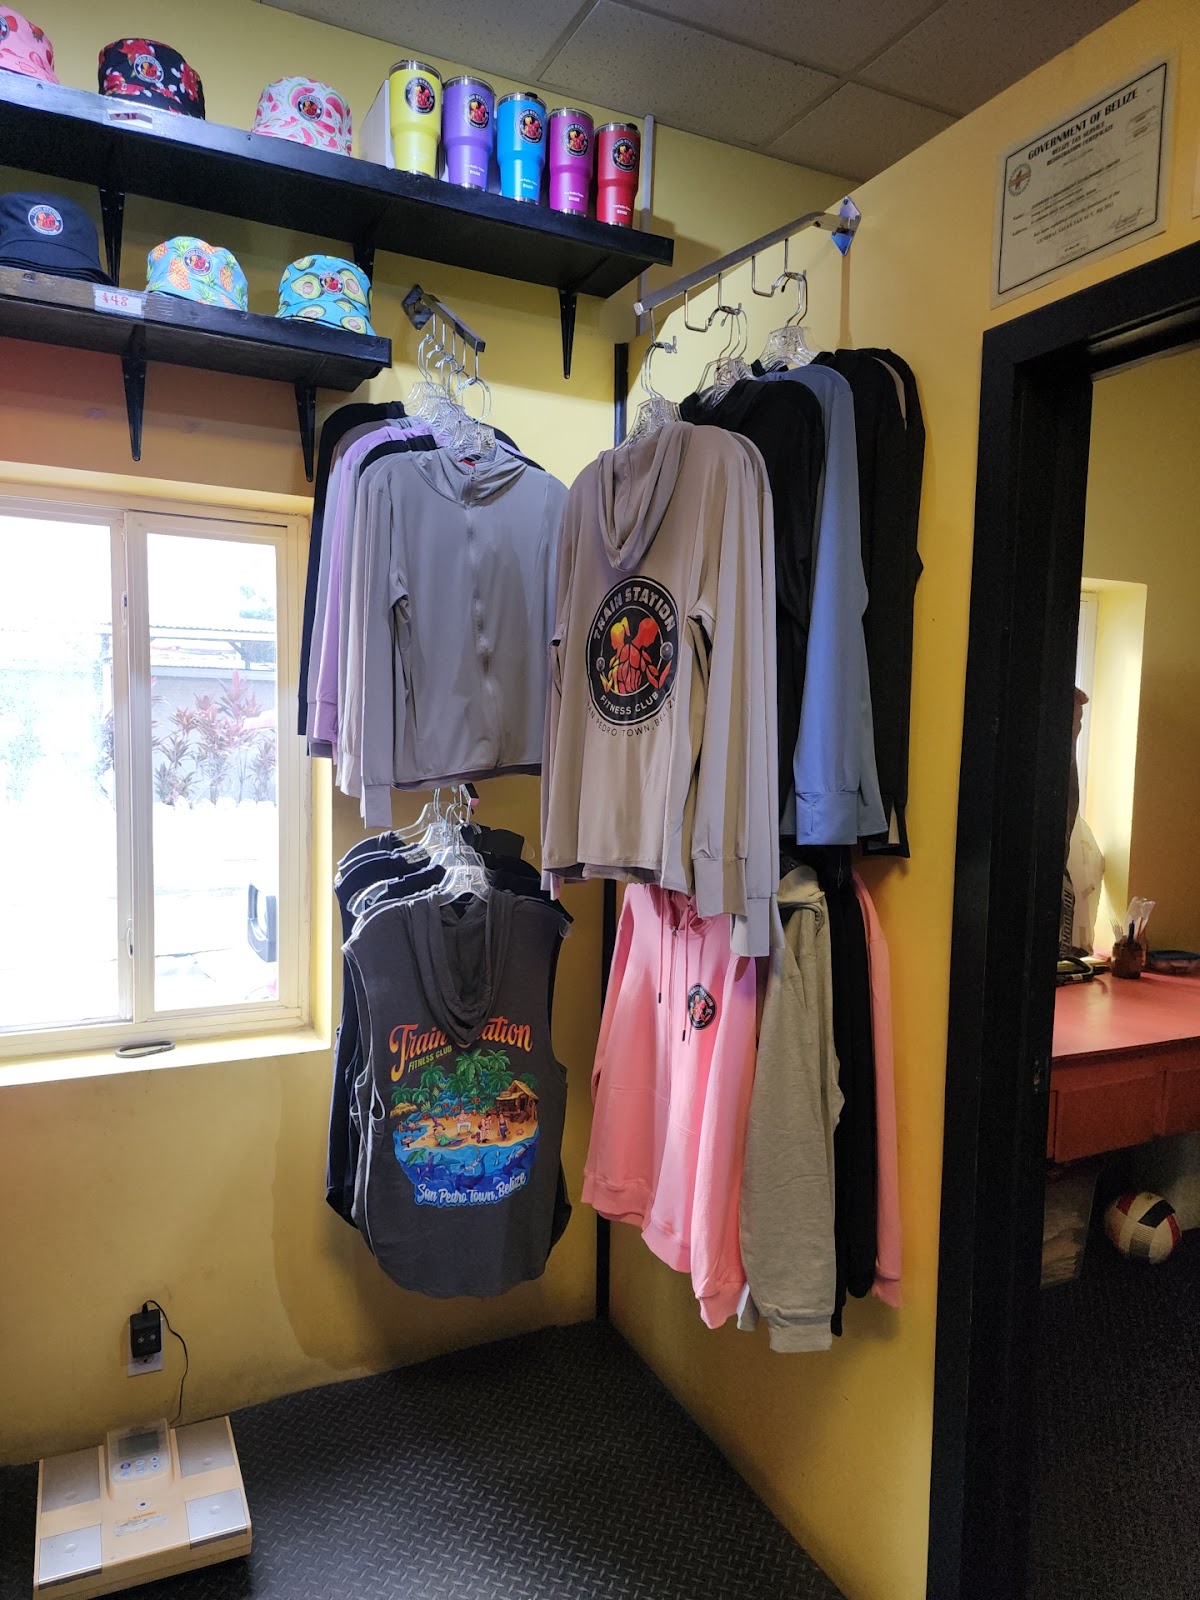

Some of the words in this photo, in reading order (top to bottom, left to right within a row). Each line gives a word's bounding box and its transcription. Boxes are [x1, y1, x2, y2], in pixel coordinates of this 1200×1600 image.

[1028, 119, 1087, 160] GOVERNMENT
[1089, 109, 1102, 125] OF
[1104, 87, 1138, 117] BELIZE
[593, 592, 623, 640] TRAIN
[625, 587, 676, 632] STATION
[600, 694, 632, 715] FITNESS
[635, 691, 659, 712] CLUB
[389, 1023, 447, 1082] Train
[466, 1015, 533, 1053] ation
[407, 1054, 434, 1073] FITNESS
[435, 1045, 453, 1059] CLUB
[417, 1183, 437, 1203] San
[438, 1188, 467, 1204] Pedro
[496, 1172, 527, 1198] Belize
